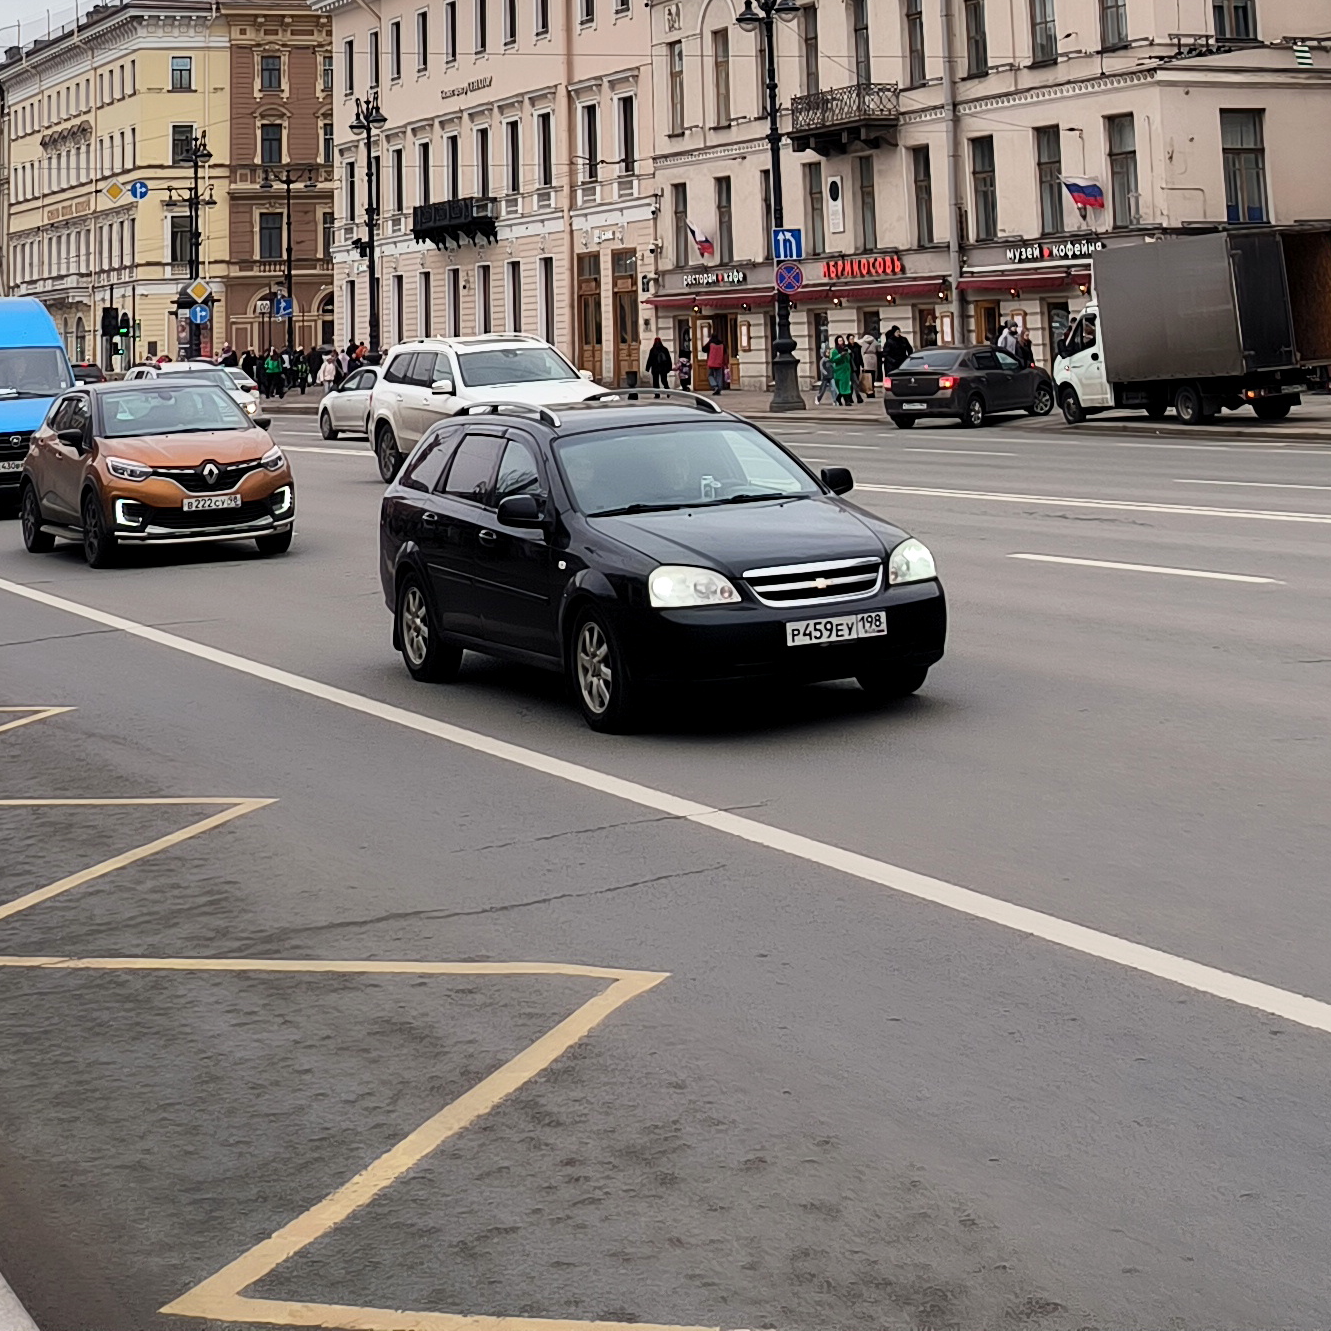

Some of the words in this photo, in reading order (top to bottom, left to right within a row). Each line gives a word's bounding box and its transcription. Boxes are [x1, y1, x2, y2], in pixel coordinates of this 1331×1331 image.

[1006, 243, 1040, 263] музей
[683, 273, 717, 288] ресторан
[724, 268, 744, 284] кафе
[821, 255, 901, 279] АБРИКОСОВЪ
[791, 620, 854, 643] Р459ЕУ
[858, 613, 882, 630] 198
